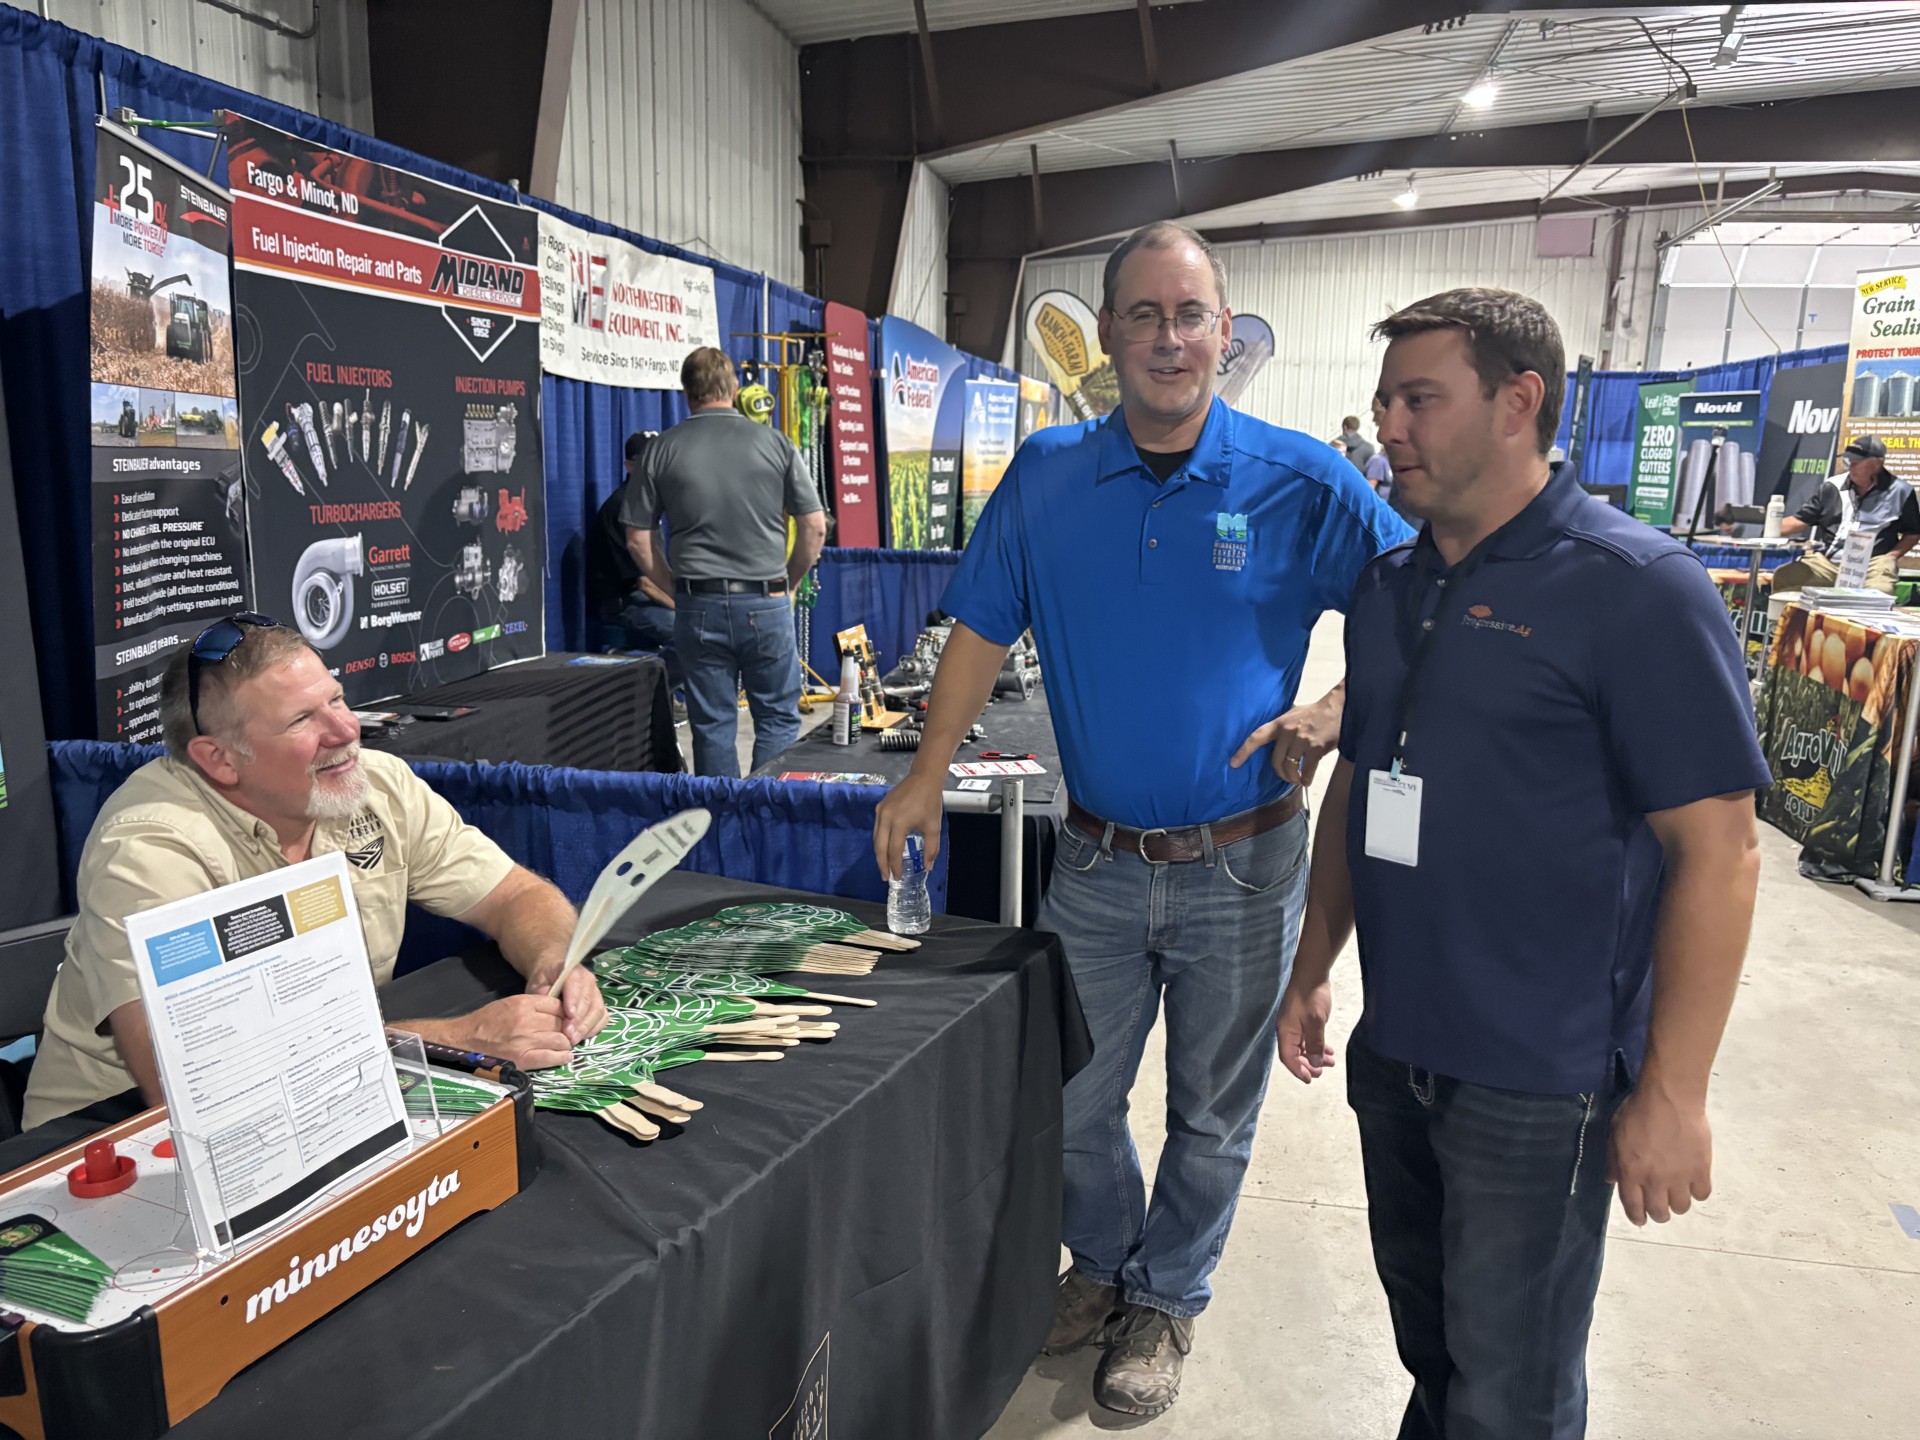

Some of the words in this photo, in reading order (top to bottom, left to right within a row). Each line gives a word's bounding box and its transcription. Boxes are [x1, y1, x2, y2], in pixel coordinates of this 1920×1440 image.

[246, 161, 284, 196] Fargo
[287, 172, 298, 198] &
[300, 179, 339, 214] Minot,
[341, 192, 359, 215] ND
[114, 212, 133, 232] MORE
[122, 231, 142, 250] MORE
[548, 235, 566, 254] Rope
[252, 227, 280, 253] Fuel
[282, 233, 334, 268] Injection
[337, 248, 372, 276] Repair
[375, 260, 394, 278] and
[396, 262, 422, 284] Parts
[429, 252, 525, 297] MIDLAND
[1876, 276, 1904, 290] SERVICE
[463, 287, 485, 300] DIESEL
[612, 280, 682, 315] NORTHWESTERN
[1863, 295, 1916, 314] Grain
[470, 316, 491, 328] SINCE
[608, 312, 662, 344] EQUIPMENT,
[666, 322, 685, 343] INC.
[1040, 311, 1067, 342] RANCH
[1063, 340, 1083, 372] FARM
[581, 346, 608, 364] Service
[610, 352, 628, 368] Since
[1856, 348, 1895, 359] PROTECT
[306, 362, 334, 384] FUEL
[337, 365, 392, 388] INJECTORS
[906, 355, 939, 384] American
[456, 376, 496, 395] INJECTION
[498, 379, 526, 397] PUMPS
[907, 386, 932, 409] Federal
[1645, 396, 1660, 408] Leaf
[1694, 402, 1742, 414] Novid
[1642, 424, 1675, 447] ZERO
[1881, 437, 1906, 448] SEAL
[1640, 448, 1672, 460] CLOGGED
[149, 457, 201, 474] advantages
[1639, 460, 1672, 474] GUTTERS
[152, 507, 180, 519] support
[310, 501, 401, 524] TURBOCHARGERS
[122, 529, 130, 540] NO
[162, 522, 204, 532] PRESSURE
[160, 538, 172, 548] the
[174, 537, 200, 550] original
[202, 536, 216, 546] ECU
[159, 555, 190, 566] changing
[191, 552, 222, 562] machines
[368, 544, 410, 564] Garrett
[172, 568, 186, 580] and
[187, 568, 204, 578] heat
[205, 565, 232, 576] resistant
[167, 586, 177, 598] (all
[178, 584, 204, 596] climate
[205, 579, 240, 592] conditions)
[374, 582, 406, 596] HOLSET
[166, 602, 195, 613] settings
[196, 598, 220, 608] remain
[221, 596, 228, 606] in
[228, 594, 244, 606] place
[370, 611, 422, 628] BorgWarner
[116, 640, 158, 666] STEINBAUER
[346, 658, 375, 674] DENSO
[391, 652, 416, 666] BOSCH
[246, 1170, 461, 1324] minnesoyta
